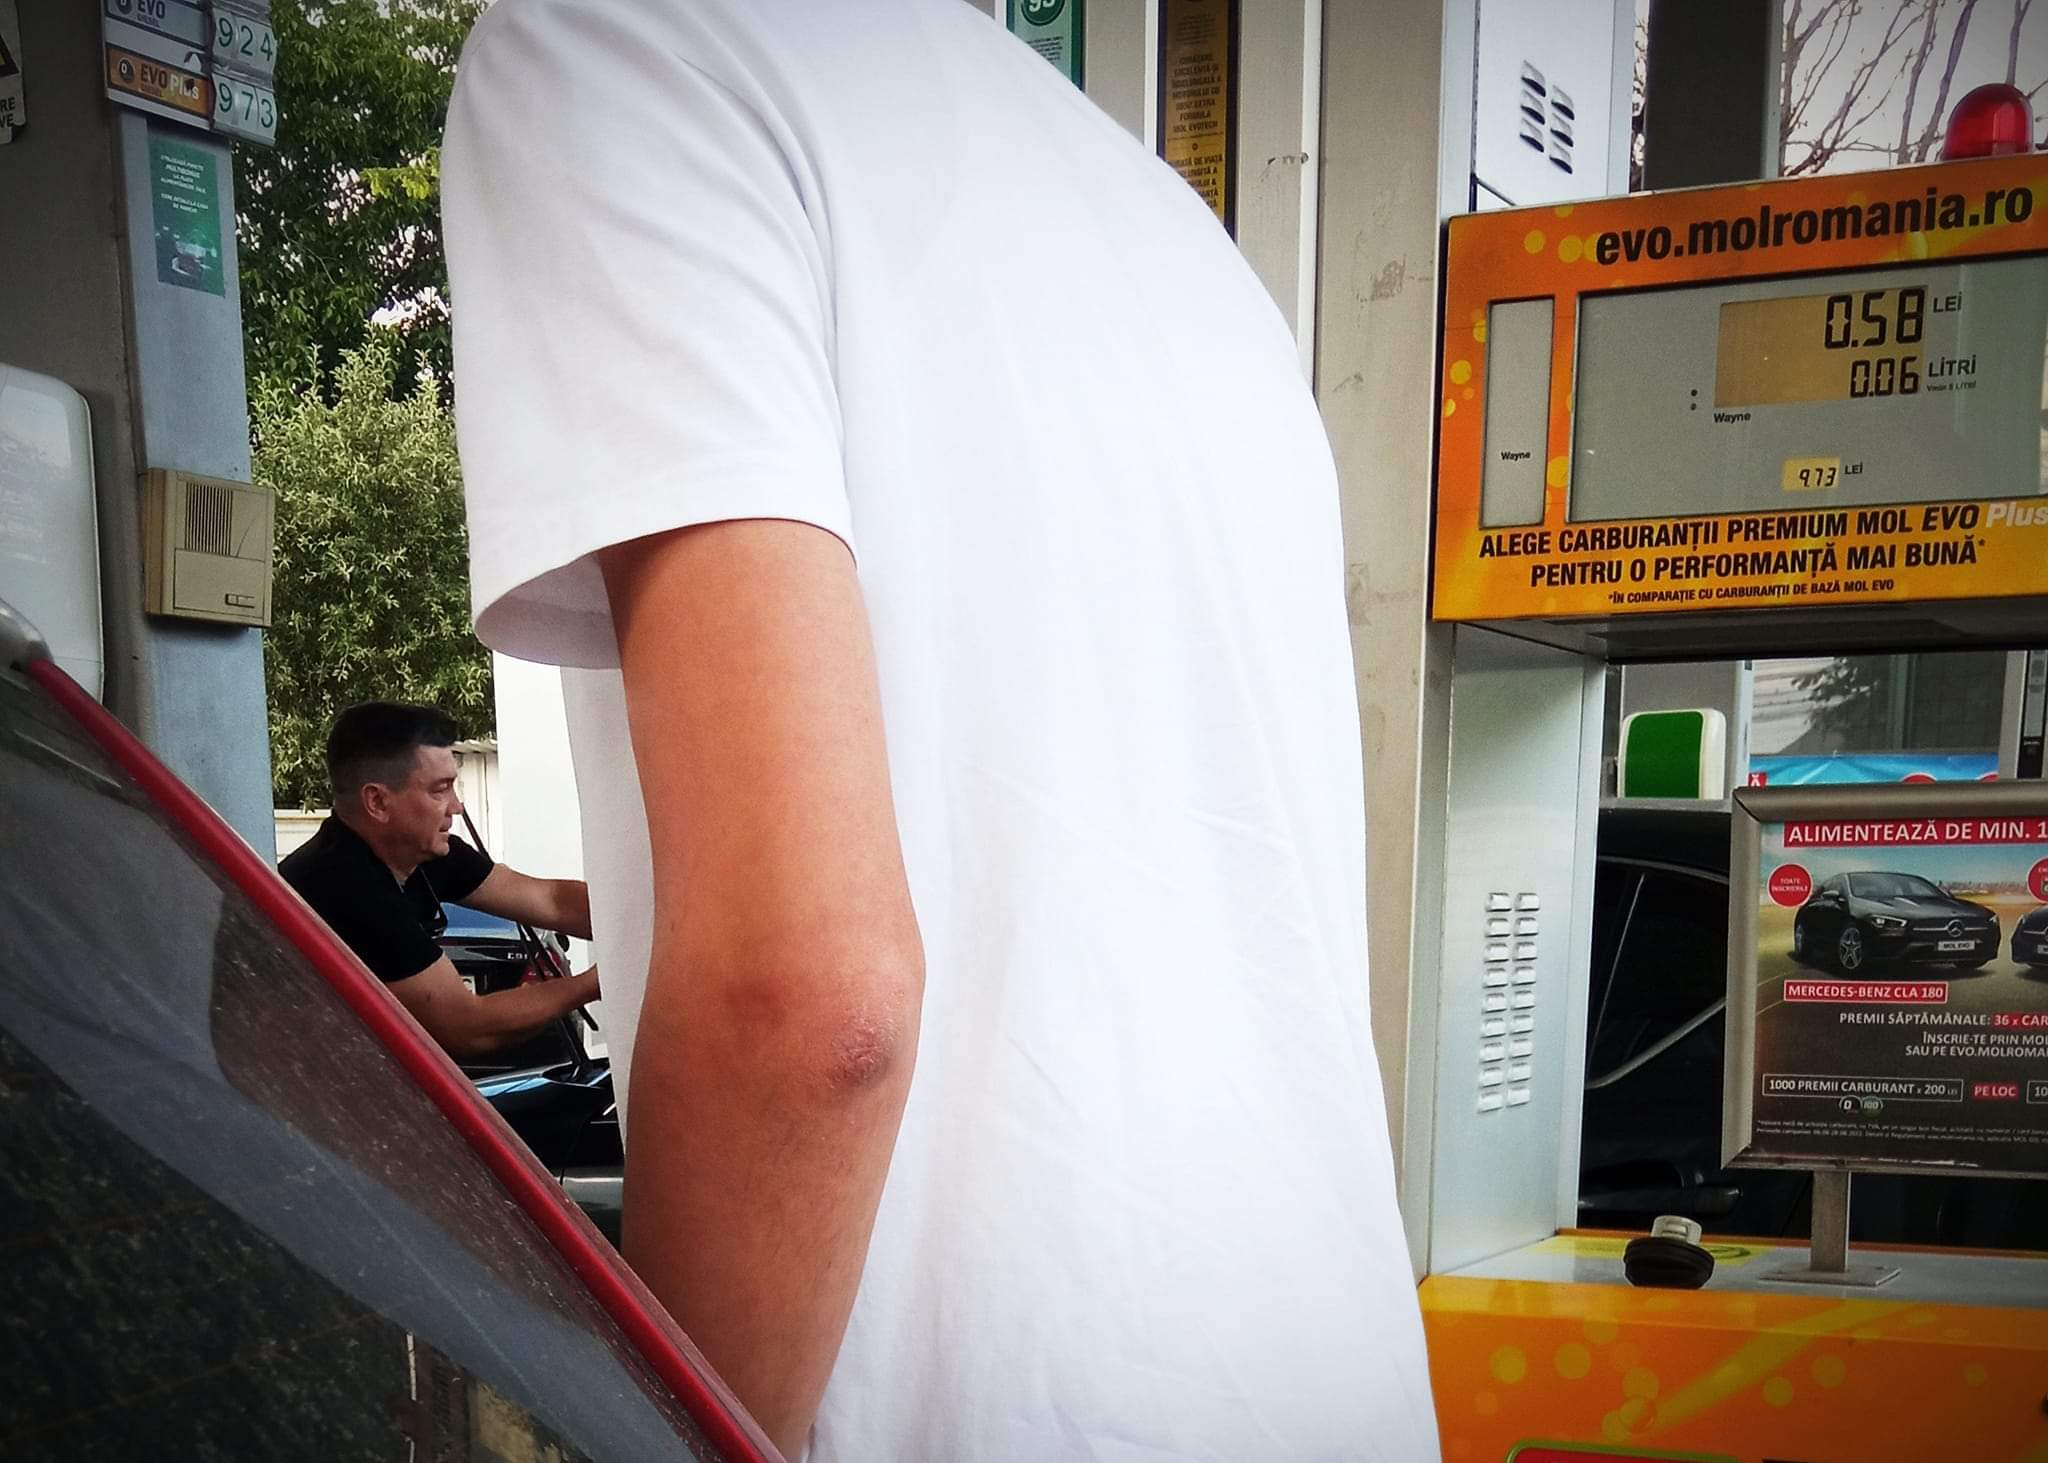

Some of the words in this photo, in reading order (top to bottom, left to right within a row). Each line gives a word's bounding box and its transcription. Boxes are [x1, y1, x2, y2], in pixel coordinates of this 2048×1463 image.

[137, 0, 165, 19] EVO
[141, 63, 168, 88] EVO
[1596, 186, 2033, 265] evo.molromania.ro
[1825, 289, 1925, 348] 0.58
[1851, 356, 1919, 398] 0.06
[1713, 412, 1751, 424] Wayne
[1500, 451, 1530, 461] Wayne
[1479, 531, 1551, 558] ALEGE
[1727, 511, 1848, 543] PREMIUM
[1856, 509, 1913, 535] MOL
[1922, 505, 1980, 532] EVO
[1985, 501, 2048, 529] Plus
[1531, 559, 1622, 588] PENTRU
[1630, 559, 1646, 582] O
[1846, 544, 1896, 571] MAI
[1699, 587, 1713, 600] CU
[1792, 582, 1808, 595] DE
[1811, 579, 1841, 594] BAZĂ
[1844, 581, 1869, 593] MOL
[1872, 579, 1895, 591] EVO
[1788, 820, 1938, 843] ALIMENTEAZĂ
[1945, 823, 1973, 840] DE
[1979, 821, 2030, 839] MIN.
[1788, 984, 1891, 998] MERCEDES-BENZ
[1894, 986, 1918, 998] CLA
[1921, 987, 1944, 999] 180
[1839, 1012, 1885, 1024] PREMII
[1994, 1014, 2009, 1026] 36
[1990, 1034, 2019, 1045] PRIN
[1905, 1045, 1929, 1056] SAU
[1933, 1046, 1948, 1056] PE
[1950, 1046, 2048, 1058] EVO.MOLROMA
[1769, 1079, 1796, 1090] 1000
[1798, 1080, 1839, 1092] PREMII
[1841, 1081, 1914, 1095] CARBURANT
[1924, 1084, 1945, 1095] 200
[1974, 1086, 1989, 1097] PE
[1992, 1086, 2017, 1097] LOC
